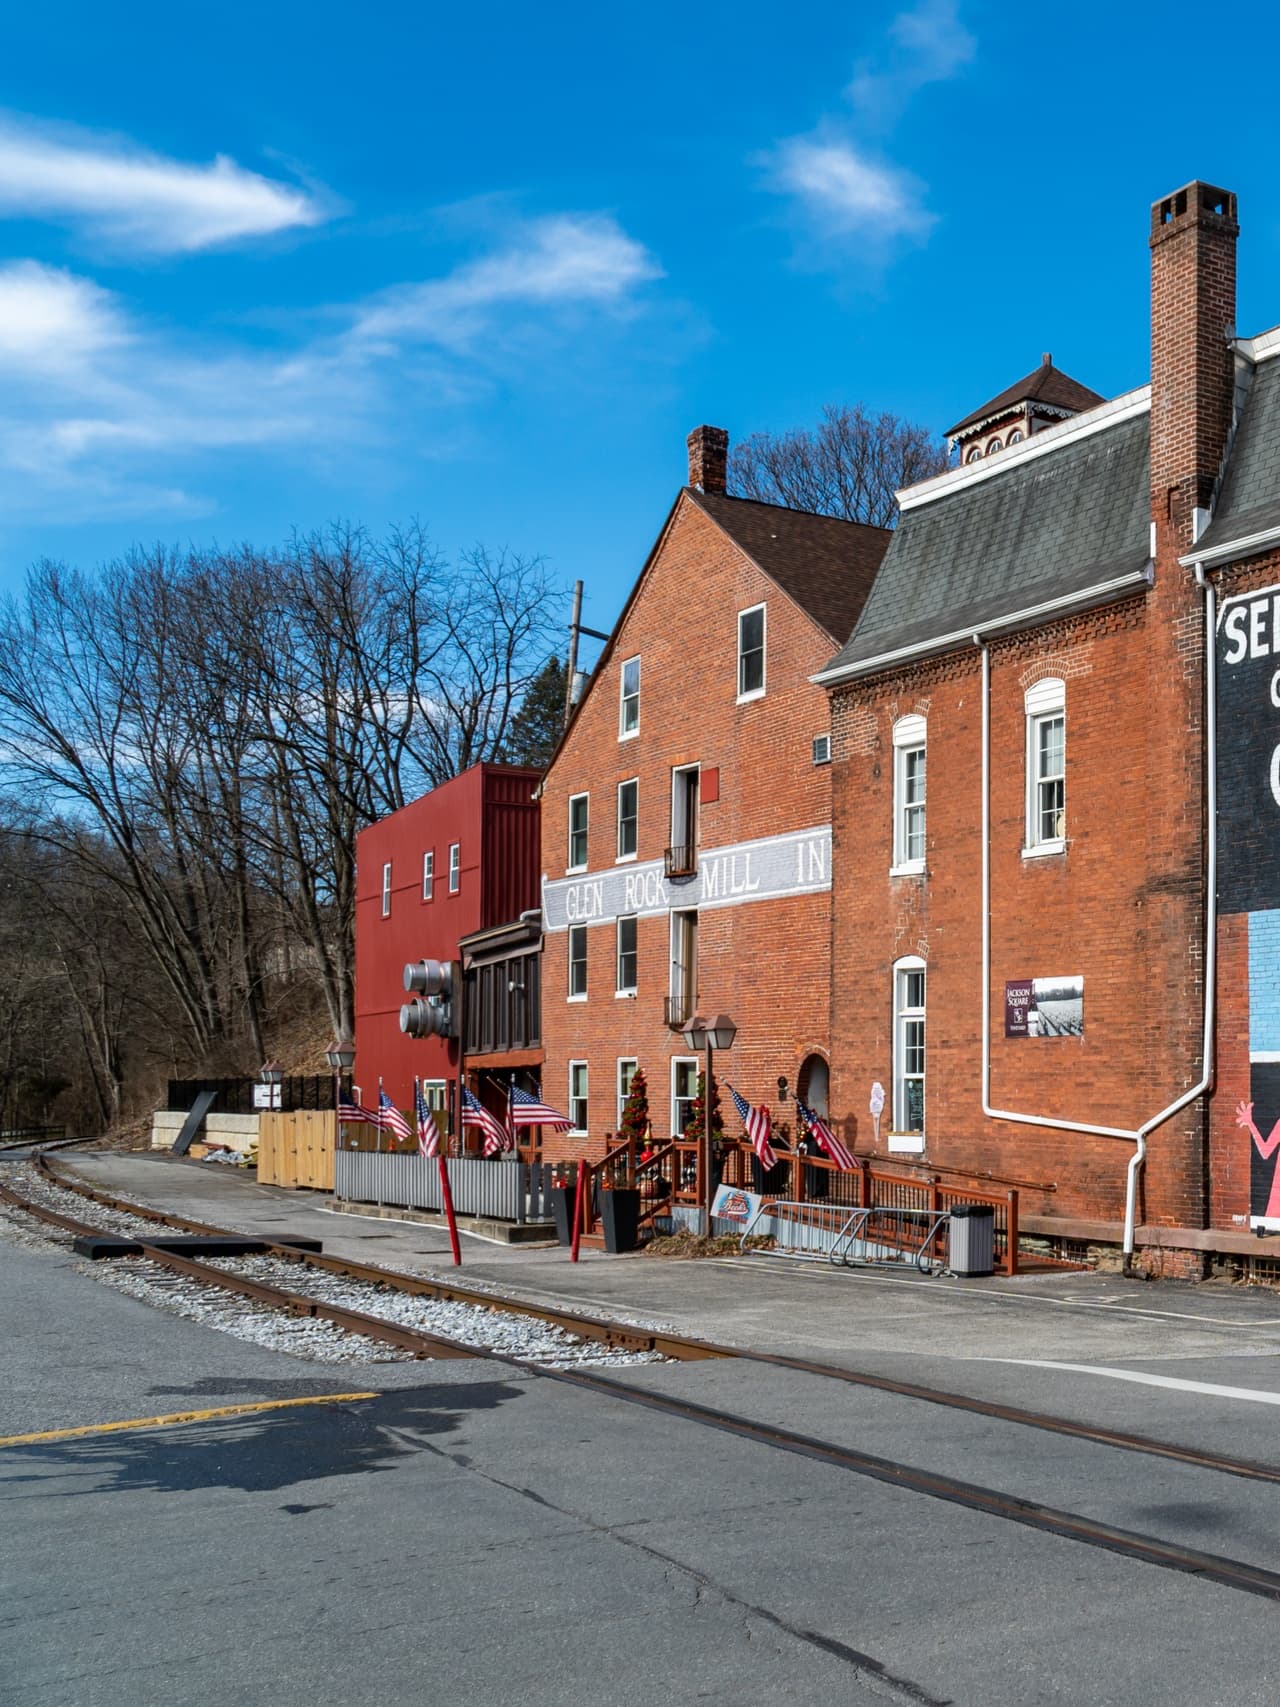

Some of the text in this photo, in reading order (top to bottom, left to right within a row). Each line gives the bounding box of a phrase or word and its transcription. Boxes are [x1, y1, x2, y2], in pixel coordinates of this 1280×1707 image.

[566, 837, 832, 921] GLEN ROCK MILL IN
